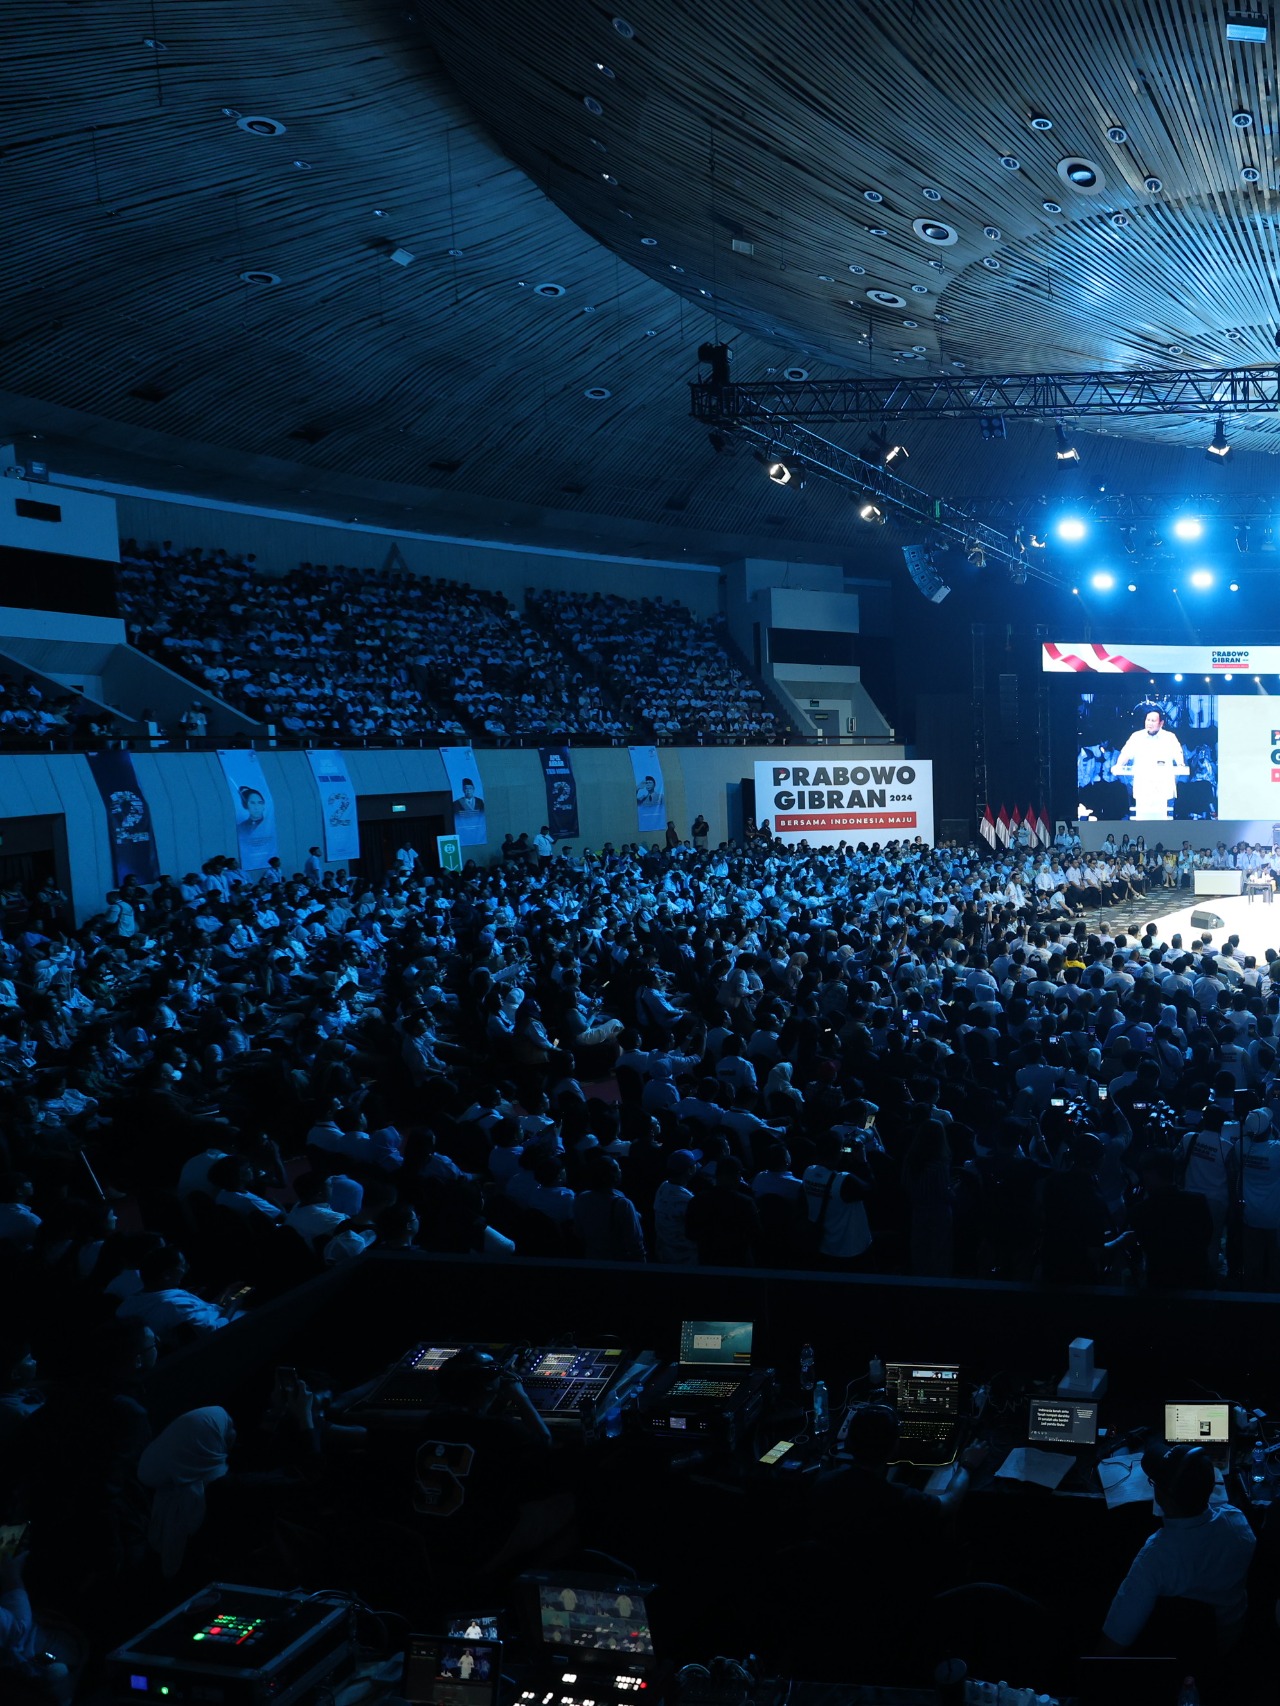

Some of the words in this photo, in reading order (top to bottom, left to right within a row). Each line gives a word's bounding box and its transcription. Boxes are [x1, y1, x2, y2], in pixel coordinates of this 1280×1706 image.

[772, 766, 916, 786] PRABOWO
[774, 789, 886, 811] GIBRAN
[889, 794, 913, 802] 2024
[830, 817, 885, 825] INDONESIA
[413, 1440, 475, 1517] S
